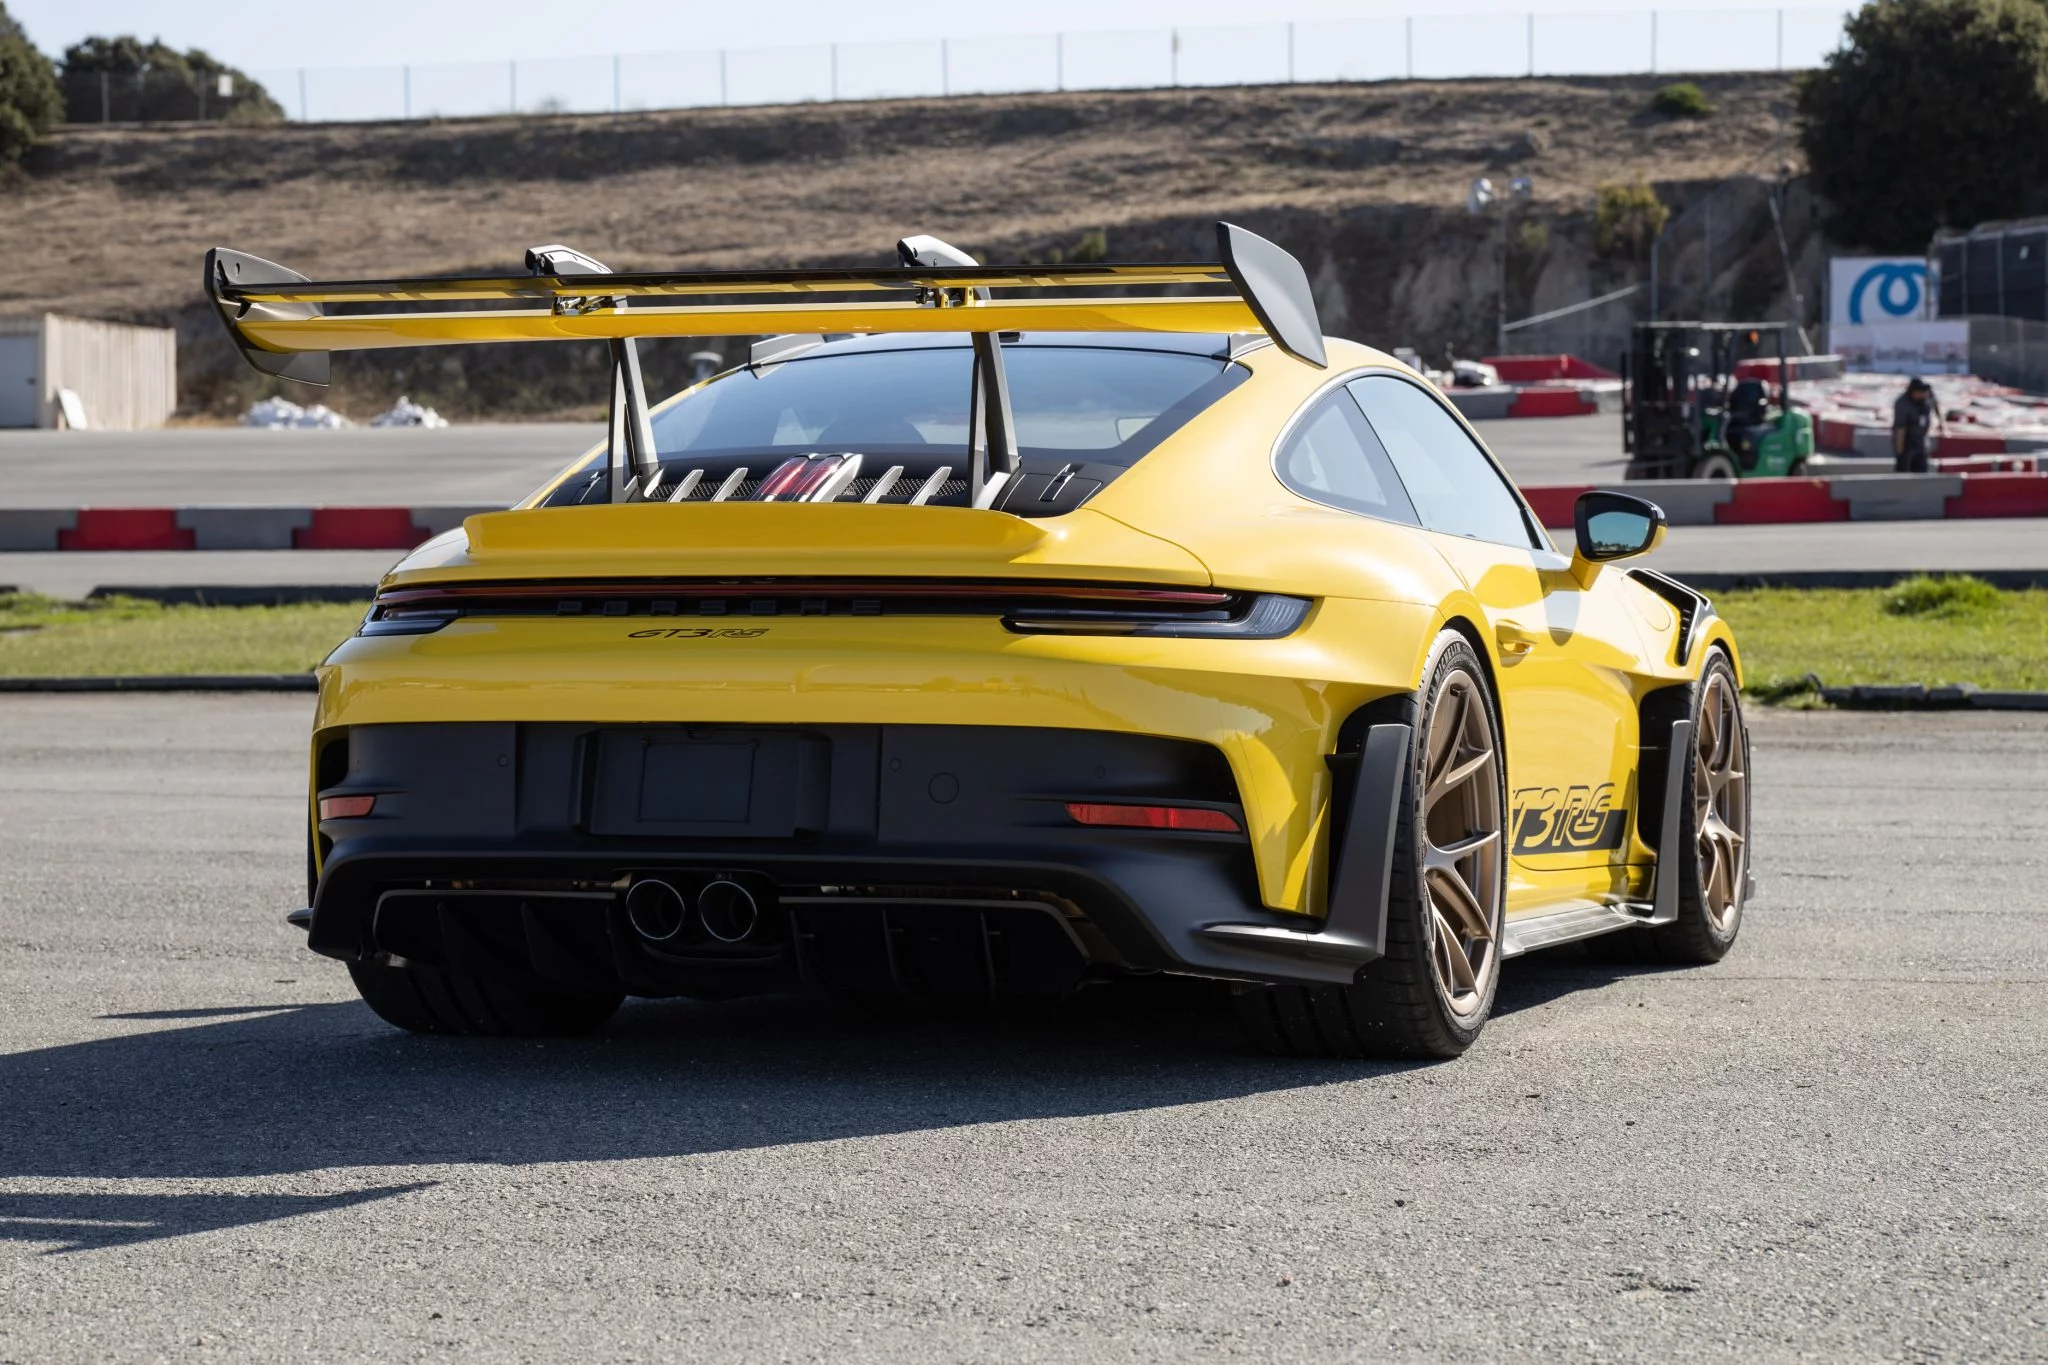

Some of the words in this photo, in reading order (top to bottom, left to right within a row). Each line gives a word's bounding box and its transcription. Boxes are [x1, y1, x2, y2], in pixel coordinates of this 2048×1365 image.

[557, 599, 882, 615] PORSCHE
[1434, 641, 1461, 686] MICHELIN
[1512, 782, 1616, 850] T3RS
